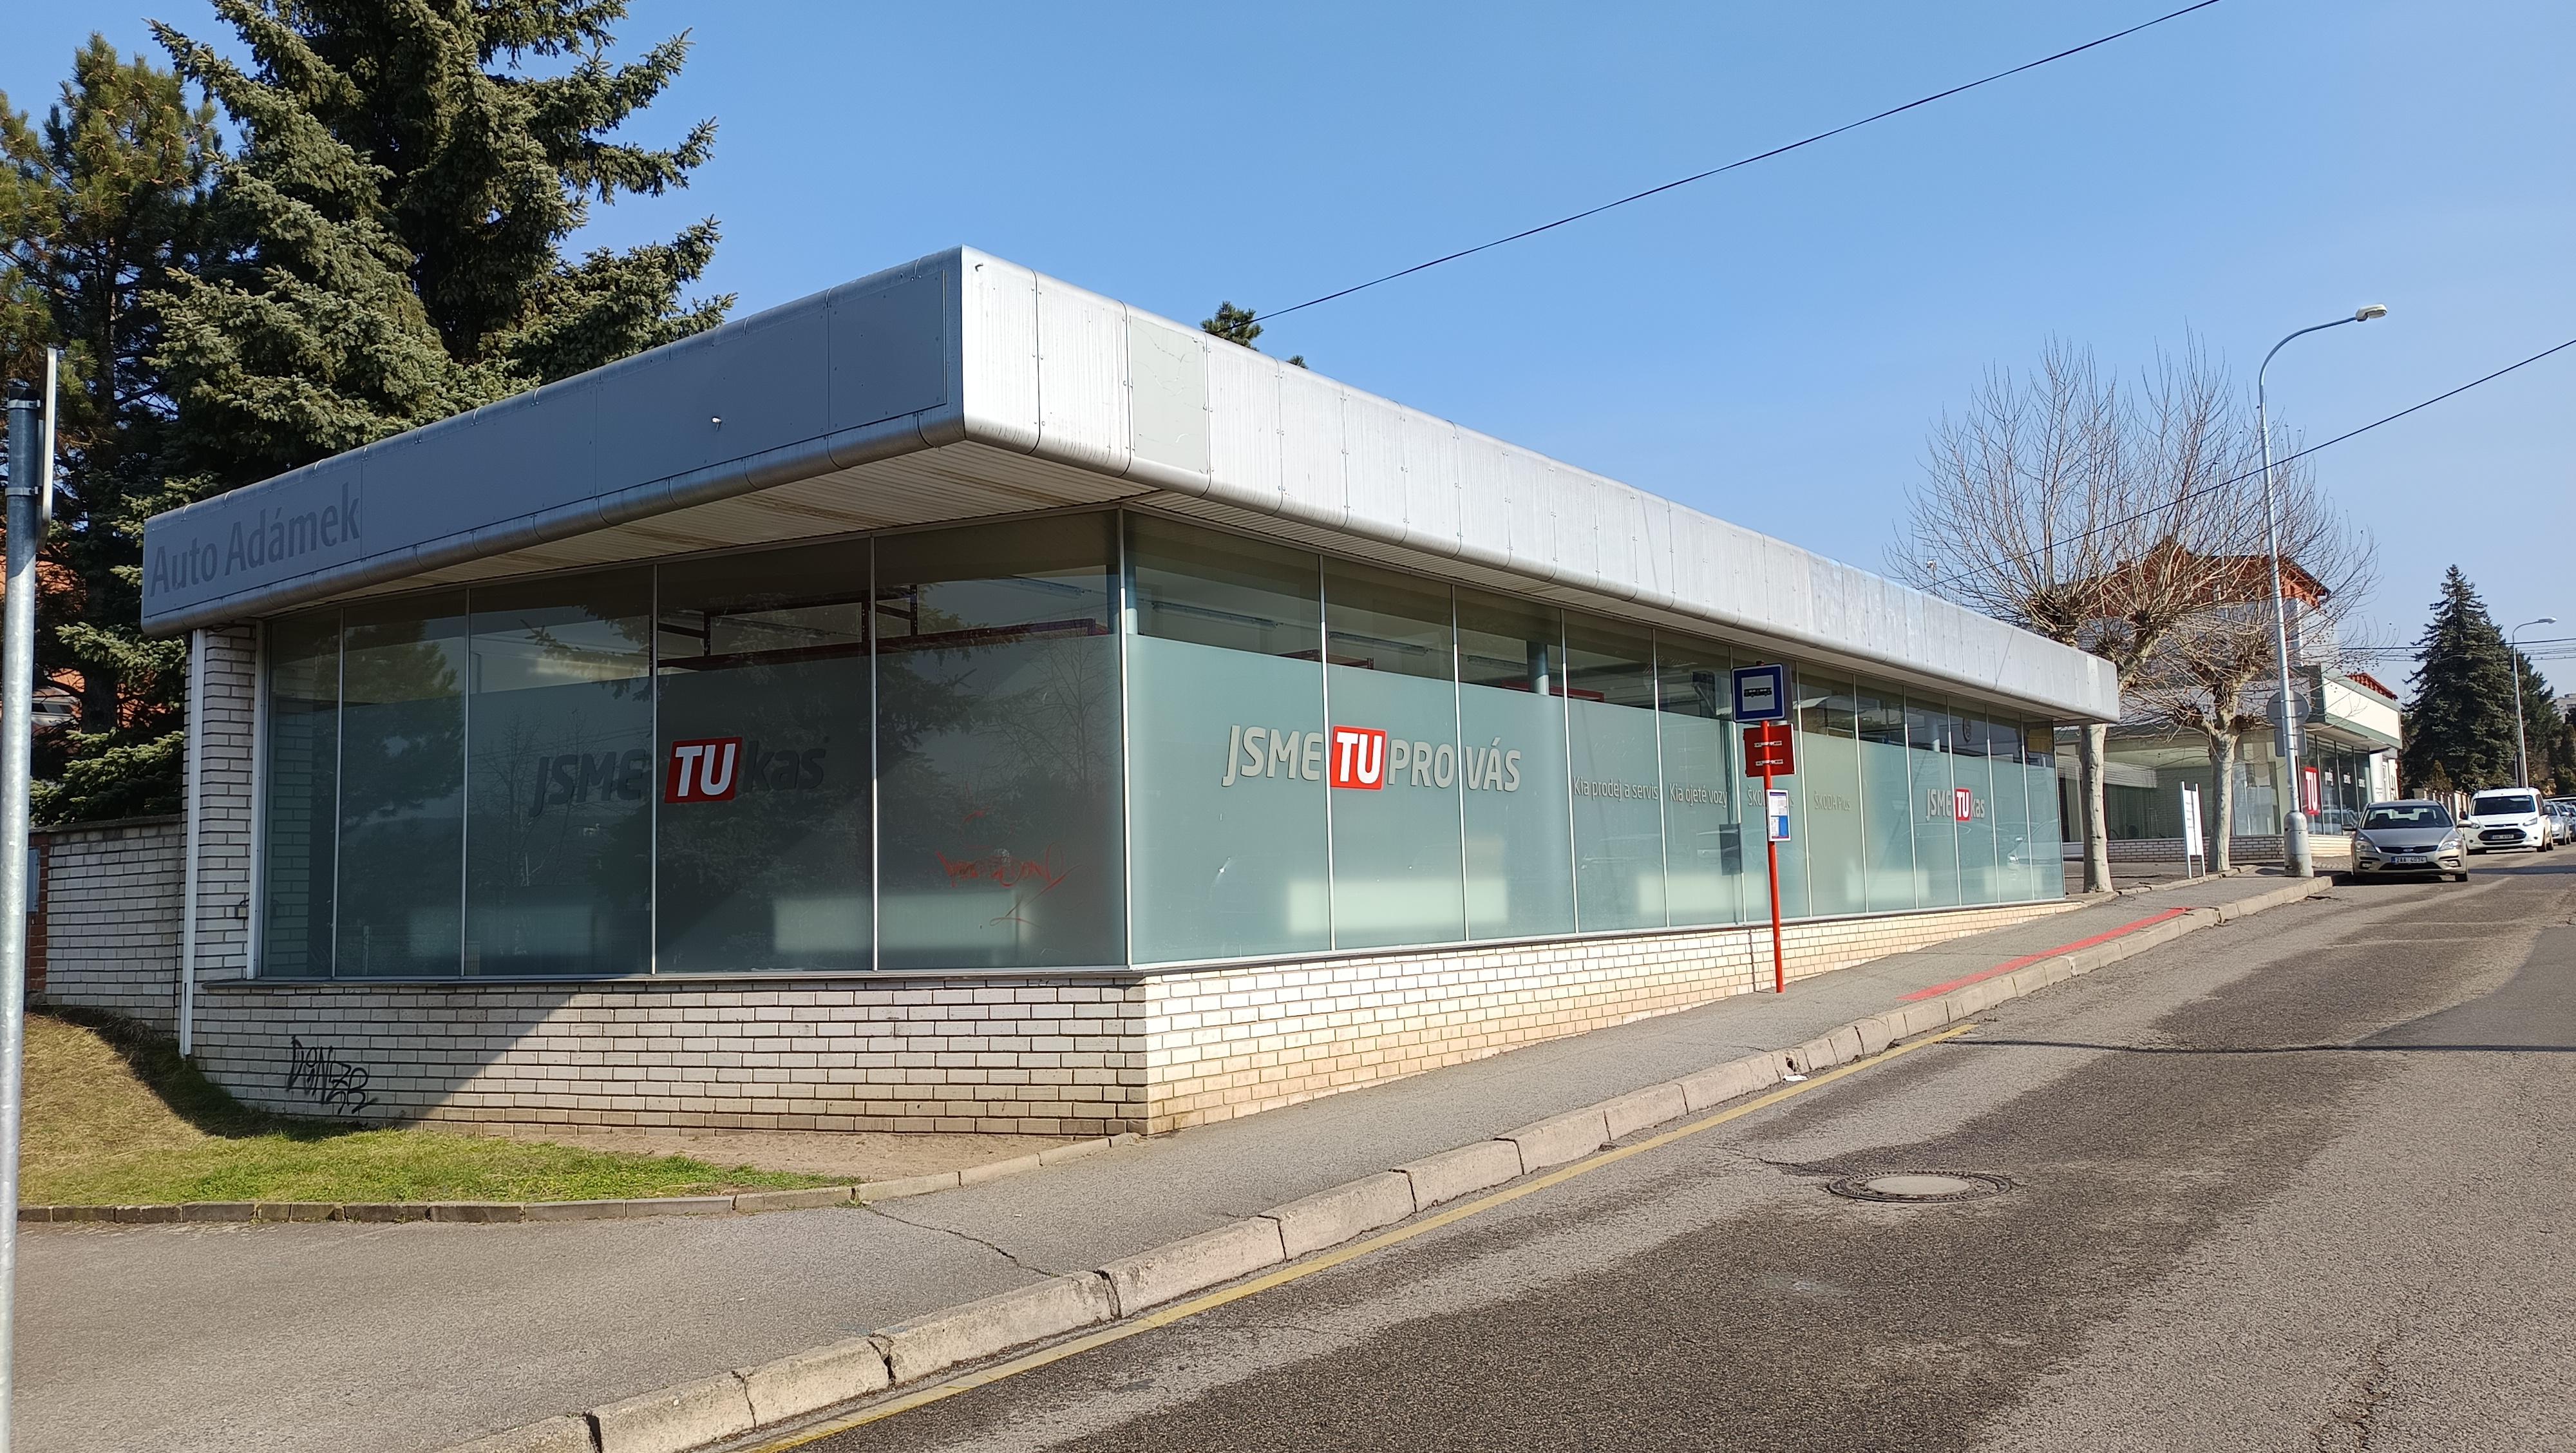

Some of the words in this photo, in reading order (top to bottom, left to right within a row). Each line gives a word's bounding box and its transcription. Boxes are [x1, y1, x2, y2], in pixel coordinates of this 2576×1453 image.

[149, 537, 218, 597] Auto
[224, 482, 360, 576] Adámek
[1222, 725, 1323, 788] JSME
[1336, 731, 1383, 784] TU
[1388, 739, 1455, 789] PRO
[1465, 737, 1520, 792] VÁS
[529, 749, 647, 817] JSME
[1573, 776, 1589, 795] Kia
[1592, 779, 1622, 801] prodej
[1624, 783, 1631, 798] a
[1633, 782, 1659, 800] servis
[1669, 783, 1683, 801] Kia
[1685, 784, 1707, 806] ojeté
[1709, 789, 1728, 808] vozy
[2306, 771, 2318, 811] TU
[1926, 788, 1953, 821] JSME
